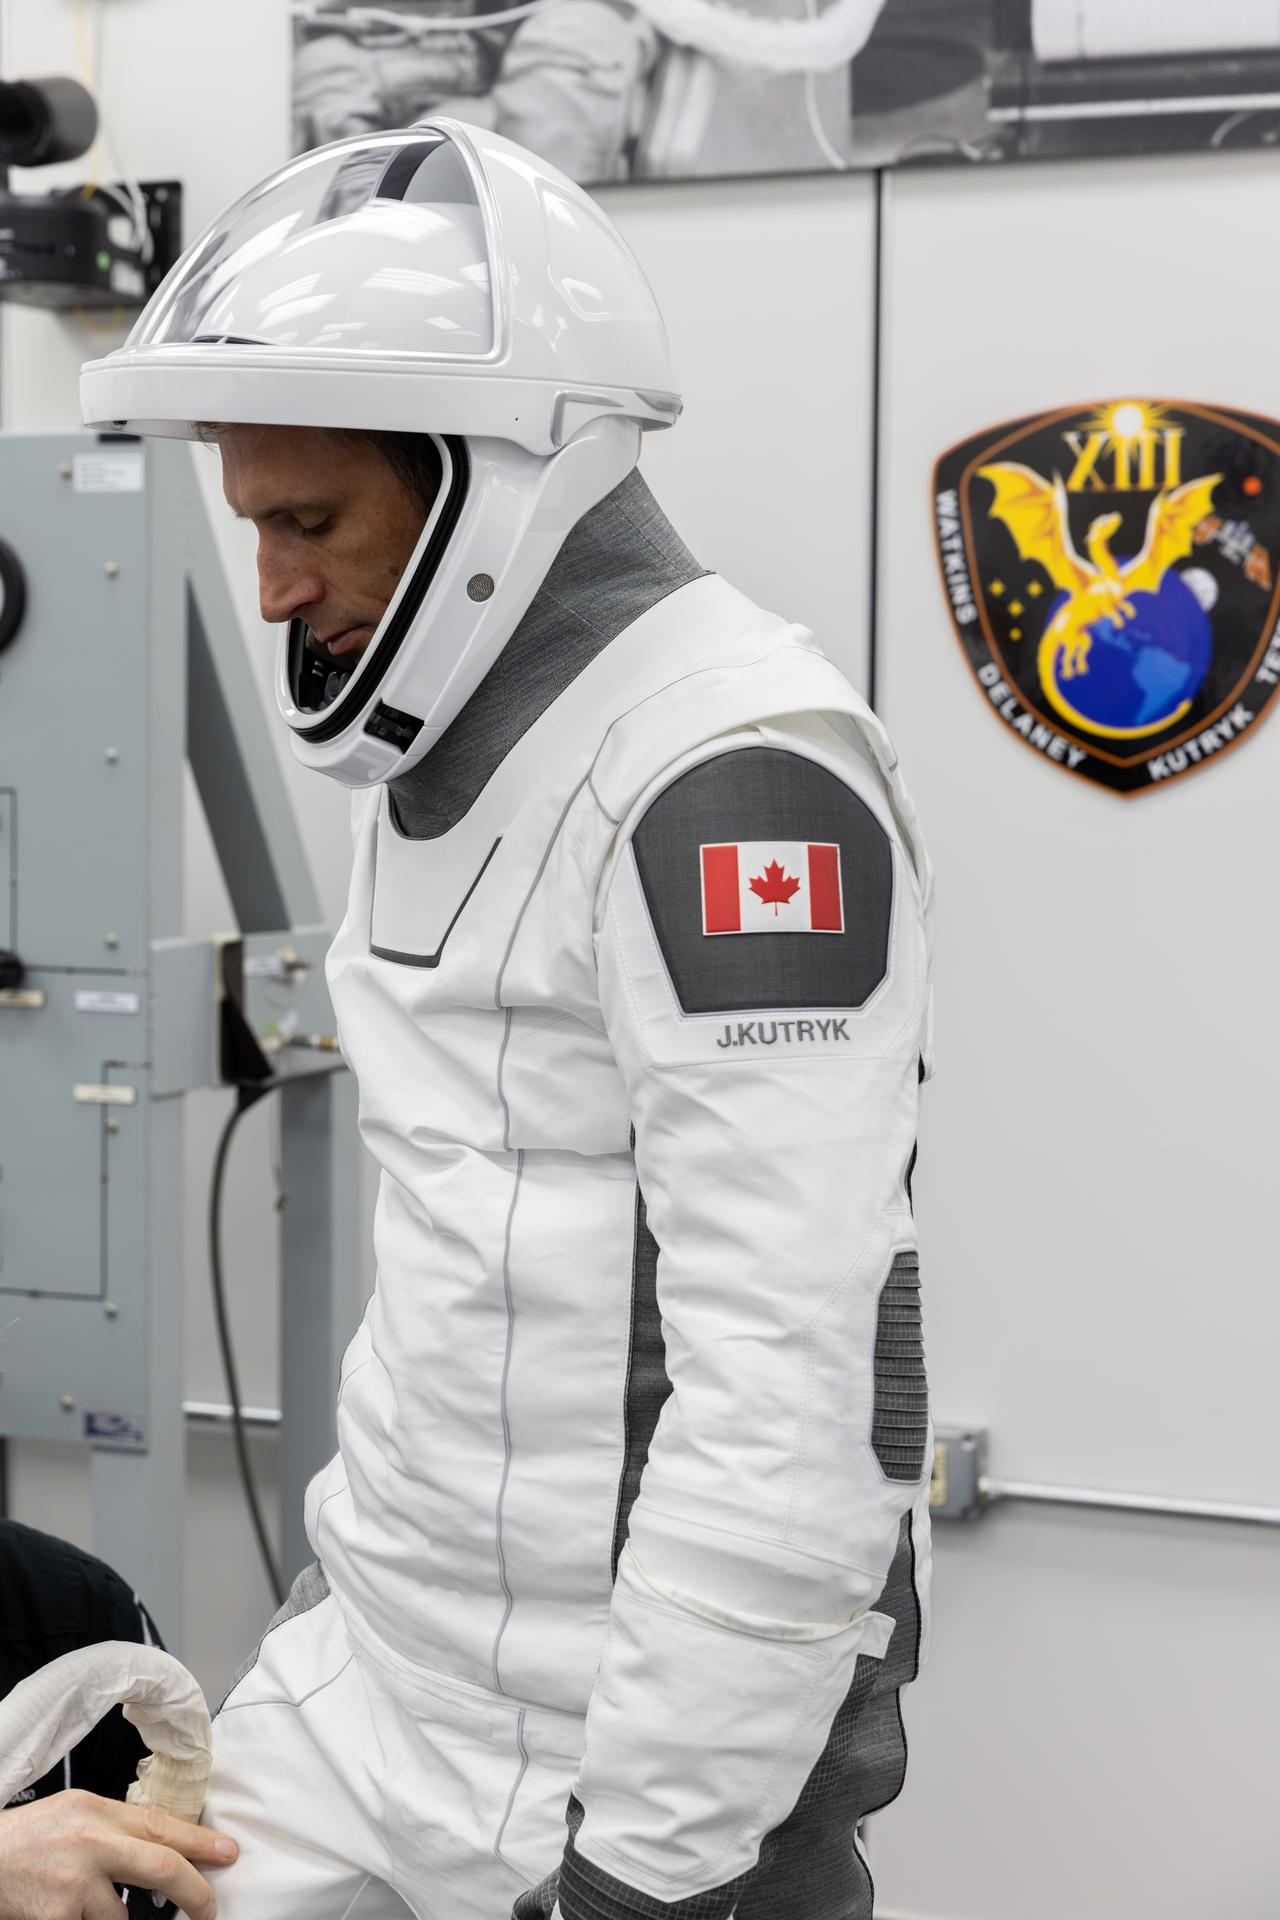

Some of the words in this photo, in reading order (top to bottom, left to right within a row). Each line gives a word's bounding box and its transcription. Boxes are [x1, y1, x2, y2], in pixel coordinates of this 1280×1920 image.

[936, 489, 977, 624] WATKINS
[1255, 617, 1280, 684] TE
[978, 661, 1087, 768] DELANEY
[1147, 702, 1254, 782] KUTRYK
[717, 1018, 850, 1048] J.KUTRYK
